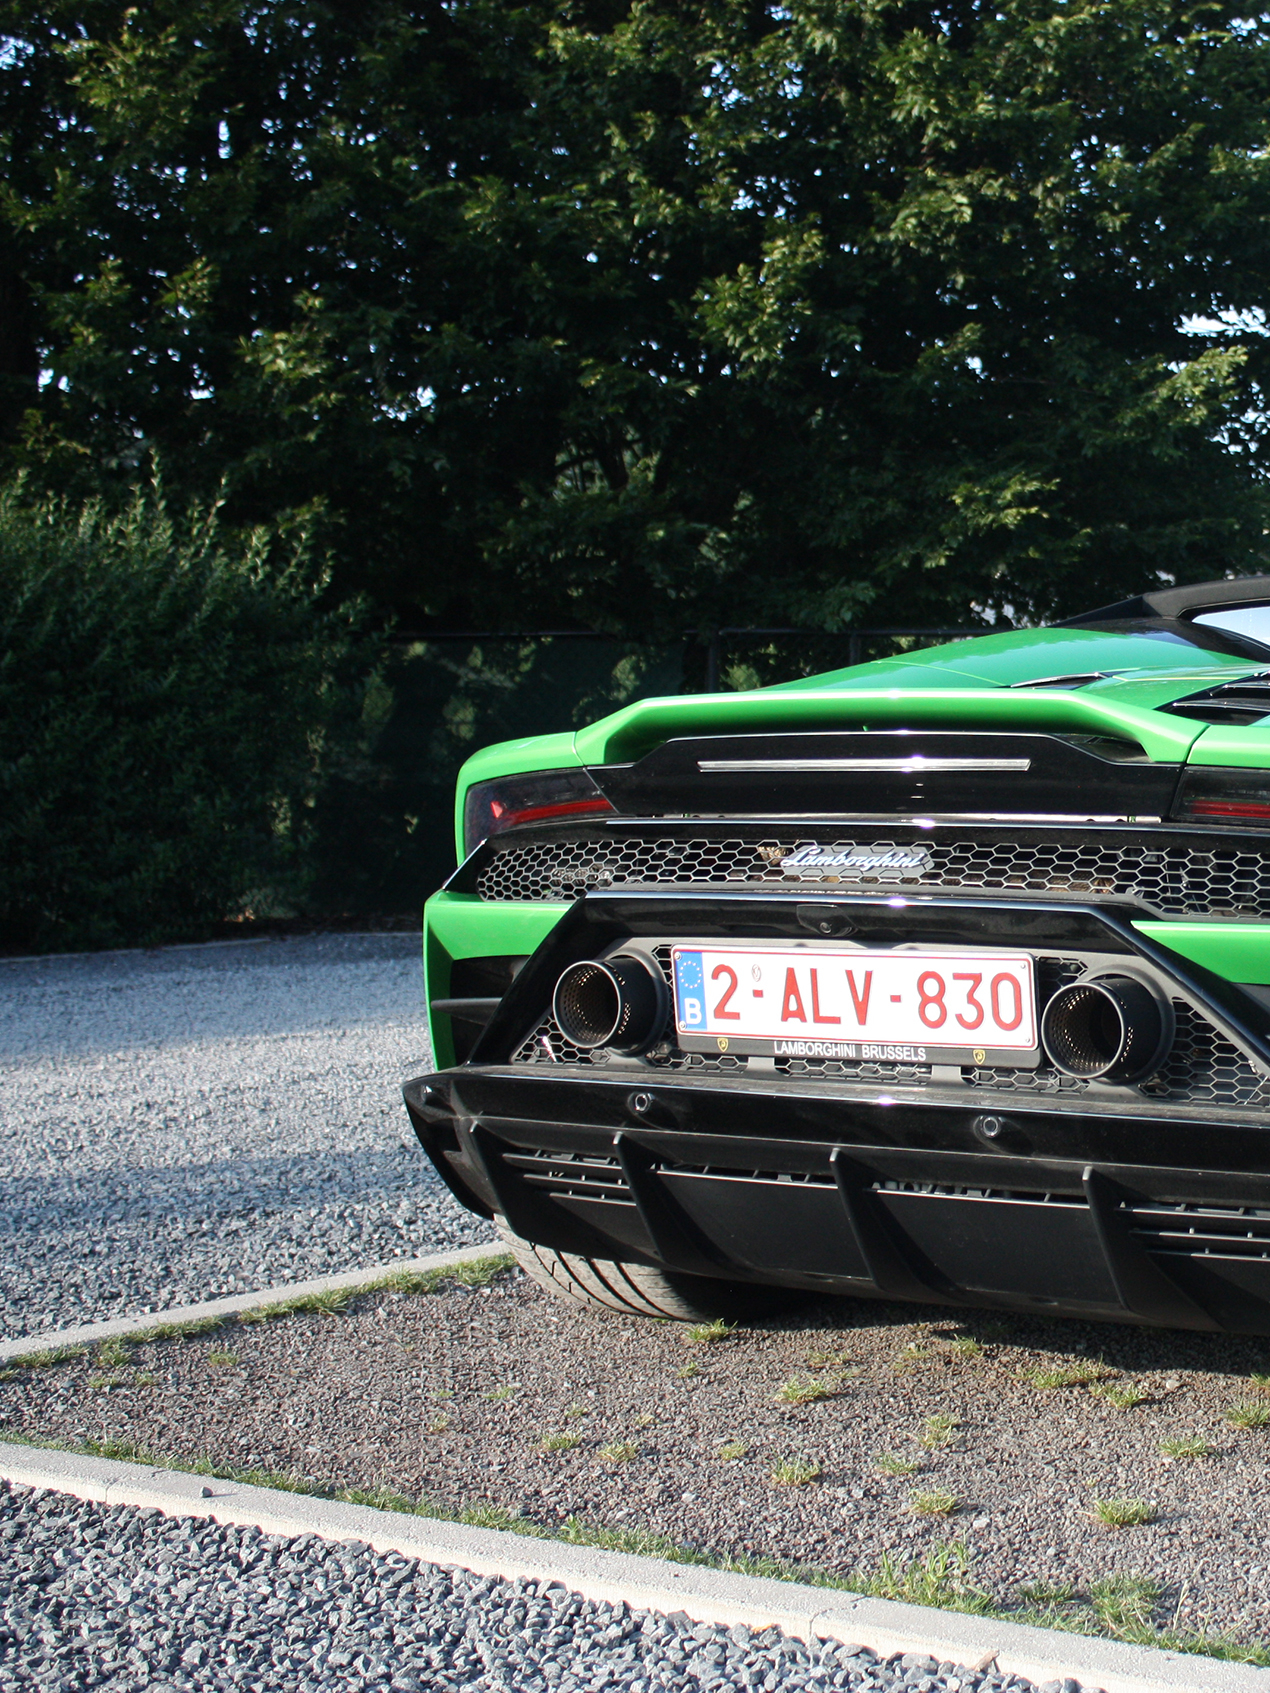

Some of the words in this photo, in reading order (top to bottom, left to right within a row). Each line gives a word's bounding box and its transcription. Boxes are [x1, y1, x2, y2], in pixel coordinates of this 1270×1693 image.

[780, 845, 926, 871] Lamborghini
[684, 998, 702, 1025] B
[773, 1040, 857, 1059] LAMBORGHINI
[861, 1043, 927, 1062] BRUSSELS
